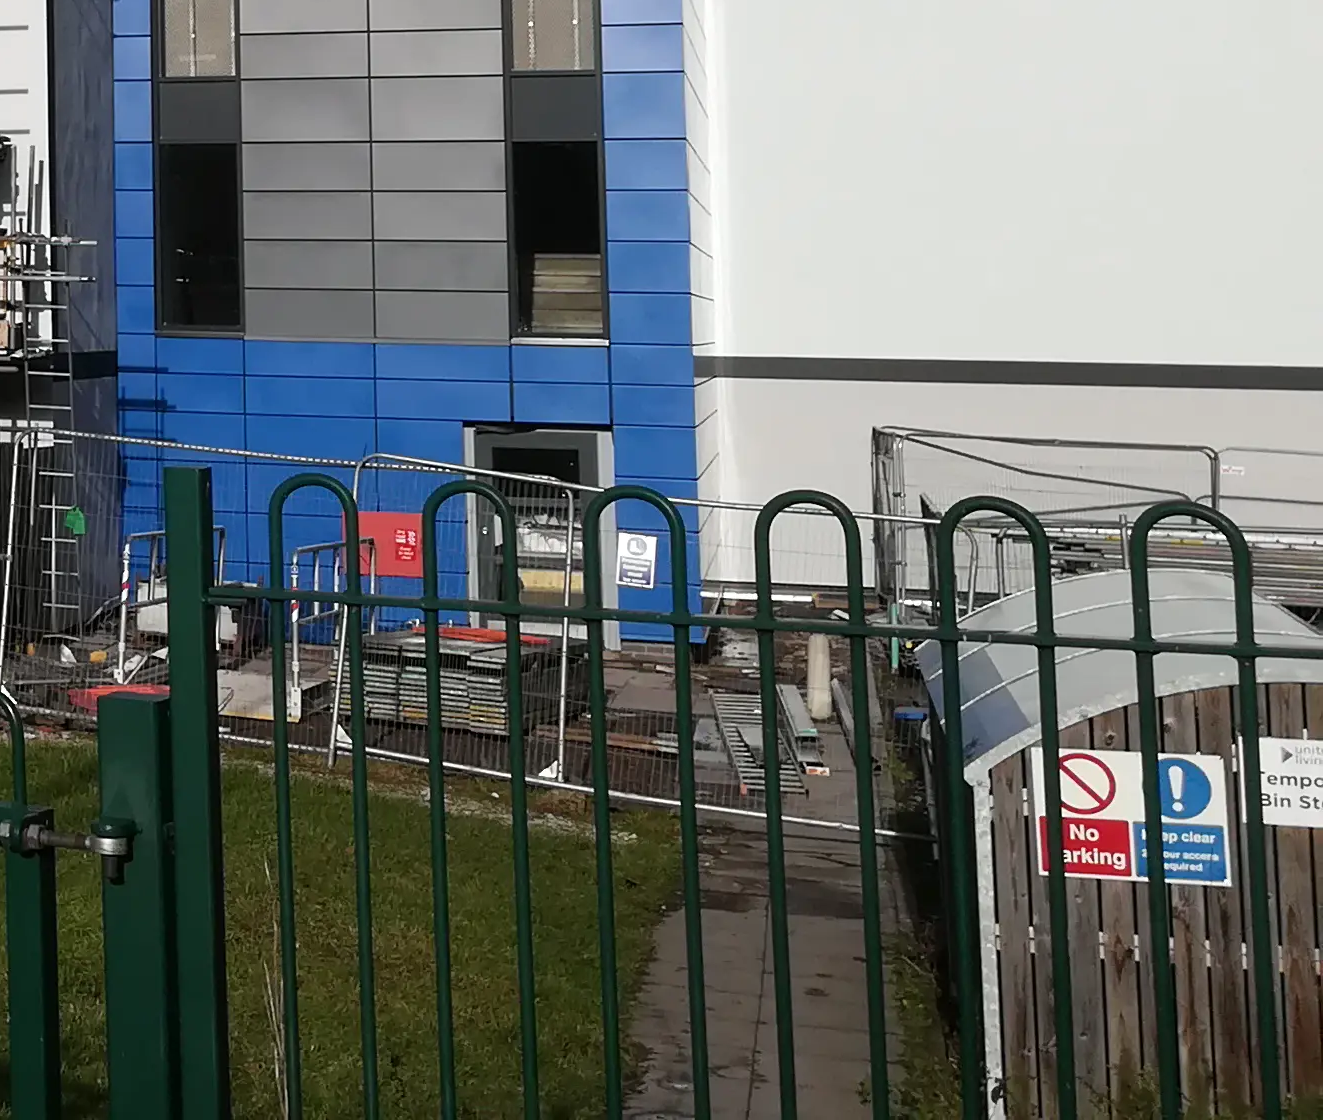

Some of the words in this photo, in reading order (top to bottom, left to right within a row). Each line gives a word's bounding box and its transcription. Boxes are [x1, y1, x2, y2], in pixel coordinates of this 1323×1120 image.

[1295, 755, 1323, 765] livin
[1261, 792, 1292, 808] Bin
[1299, 795, 1323, 810] St
[1069, 823, 1100, 842] No
[1181, 830, 1216, 844] clear
[1063, 846, 1127, 870] arking
[1163, 851, 1181, 859] our
[1163, 862, 1203, 872] equired
